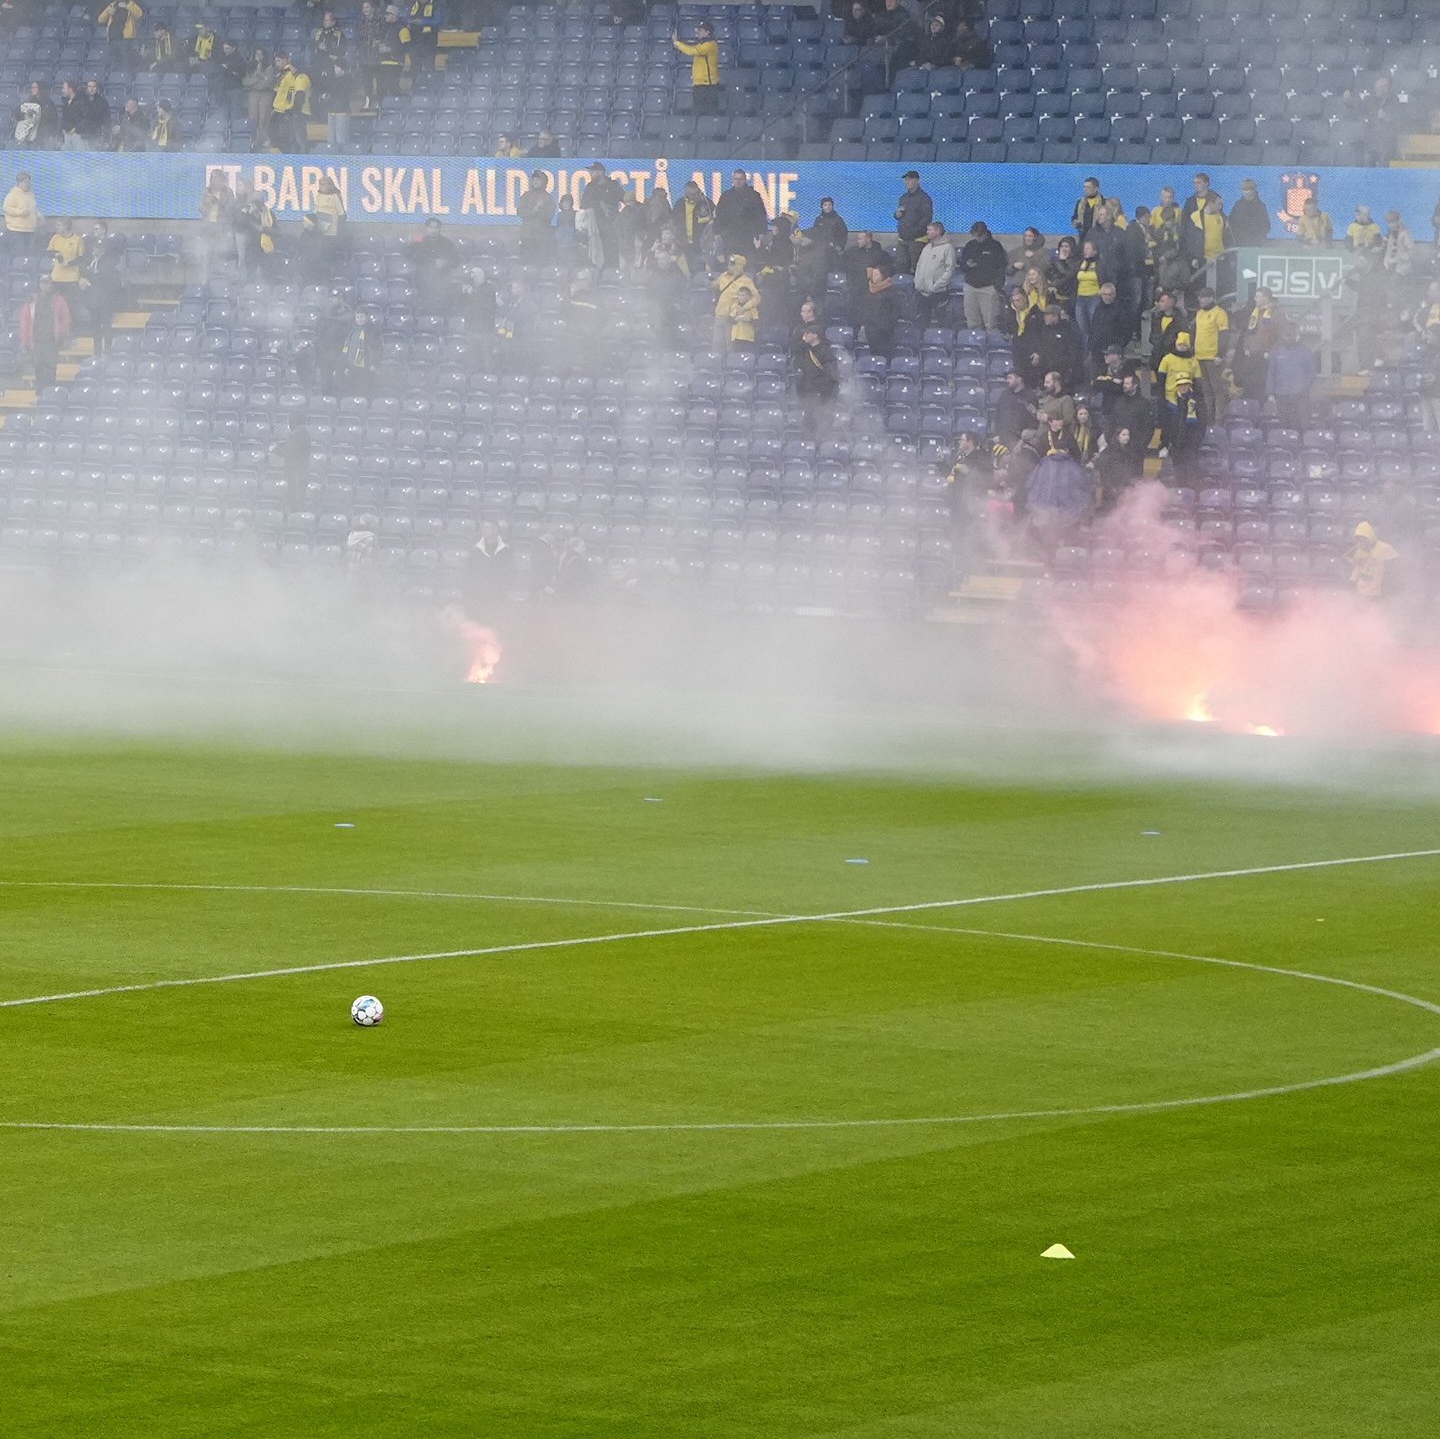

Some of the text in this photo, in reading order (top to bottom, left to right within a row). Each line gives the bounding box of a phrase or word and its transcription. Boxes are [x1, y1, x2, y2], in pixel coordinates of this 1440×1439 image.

[254, 166, 347, 212] BARN
[361, 166, 450, 213] SKAL
[1262, 271, 1337, 292] GSV
